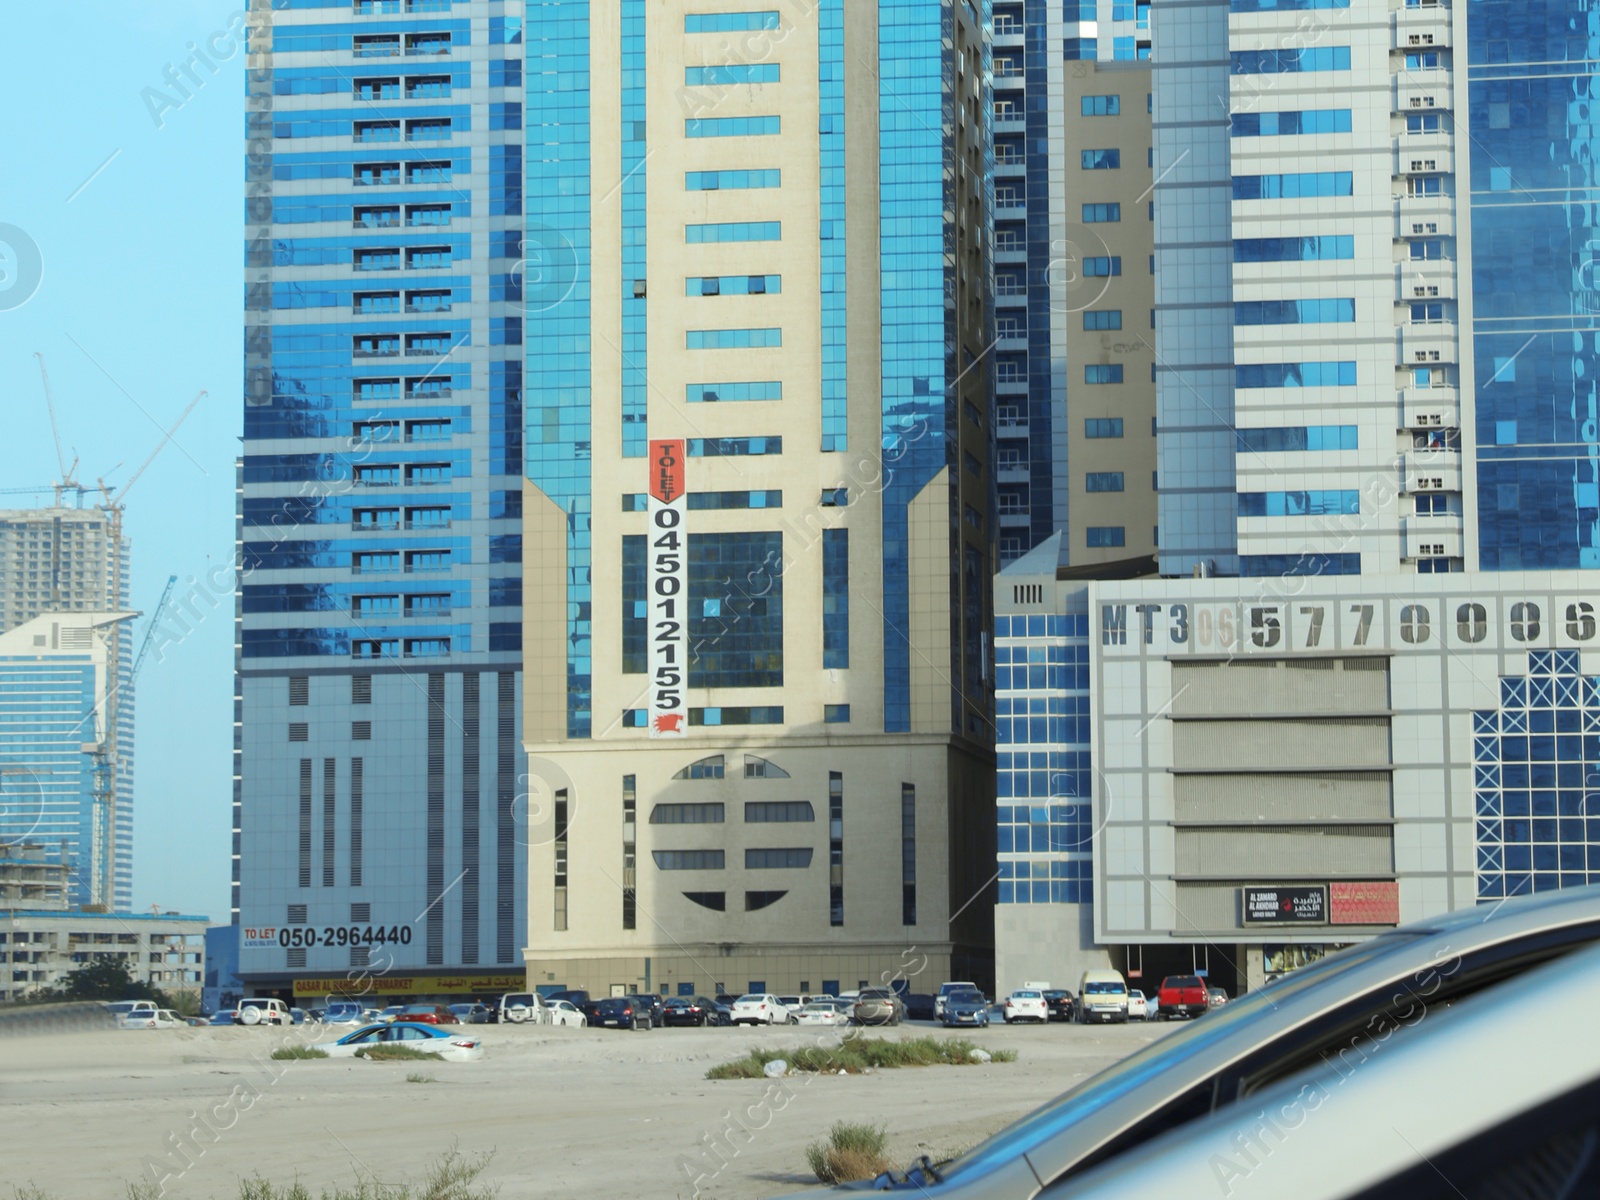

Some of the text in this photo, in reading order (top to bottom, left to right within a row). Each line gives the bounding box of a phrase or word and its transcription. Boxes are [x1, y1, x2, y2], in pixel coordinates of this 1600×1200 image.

[654, 508, 681, 709] 045012155
[244, 928, 276, 939] TO LET
[279, 925, 412, 947] 050-2964440
[322, 980, 332, 991] AL
[359, 978, 413, 990] SUPERMARKET
